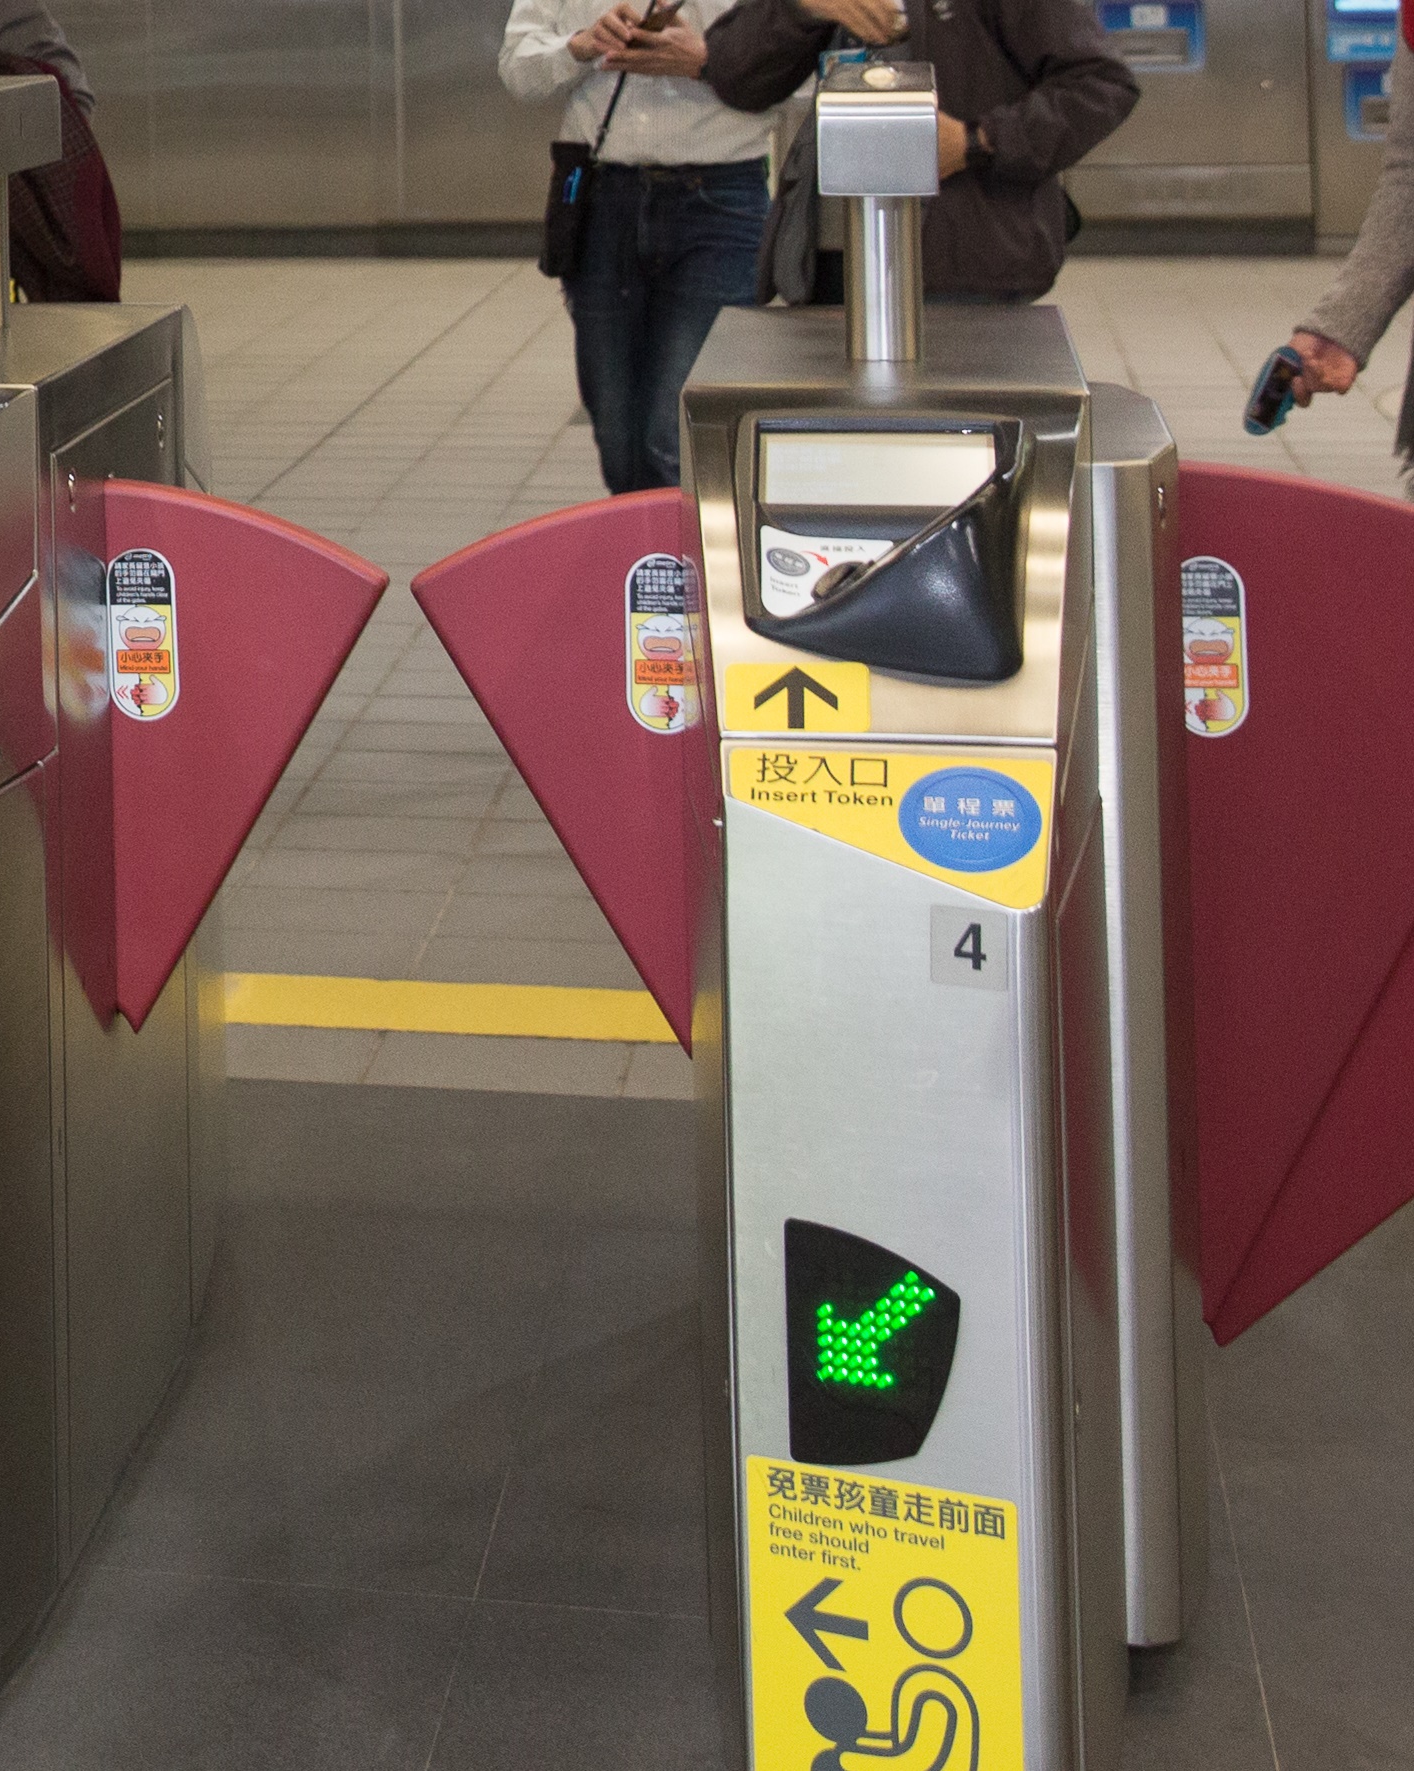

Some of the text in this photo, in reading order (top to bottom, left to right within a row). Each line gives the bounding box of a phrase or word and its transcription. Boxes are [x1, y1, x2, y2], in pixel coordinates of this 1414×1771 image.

[756, 753, 888, 788] 投入口
[751, 787, 893, 807] Insert Token
[923, 796, 1015, 817] 單程票
[950, 829, 990, 841] Ticket
[954, 922, 987, 971] 4
[766, 1466, 1006, 1540] 免票孩童走前面
[768, 1503, 945, 1550] Children who travel
[769, 1522, 869, 1553] free should
[770, 1542, 862, 1571] enter first.
